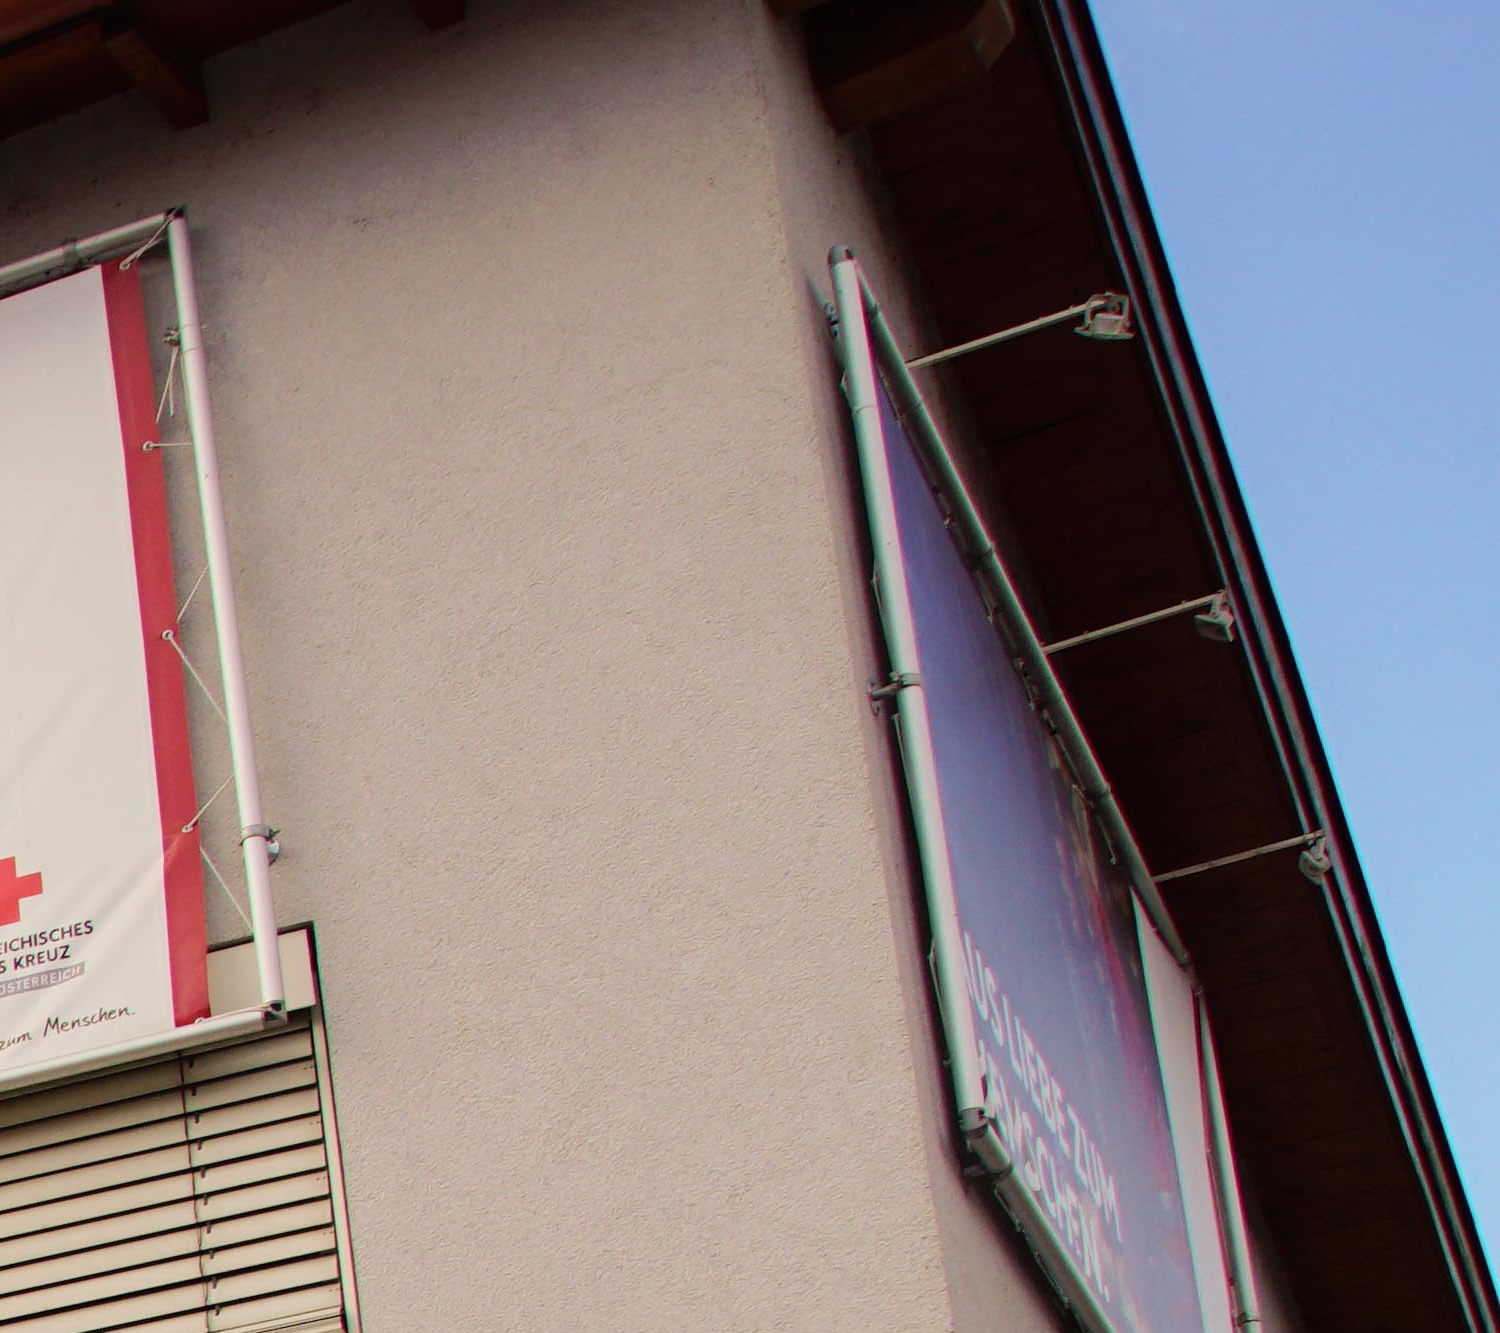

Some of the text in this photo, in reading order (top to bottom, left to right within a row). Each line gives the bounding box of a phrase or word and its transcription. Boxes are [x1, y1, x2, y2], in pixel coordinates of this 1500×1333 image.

[13, 944, 72, 971] KREUZ
[42, 1005, 137, 1038] Menschen.
[1001, 992, 1071, 1159] LIEBE
[1066, 1100, 1122, 1244] ZUM
